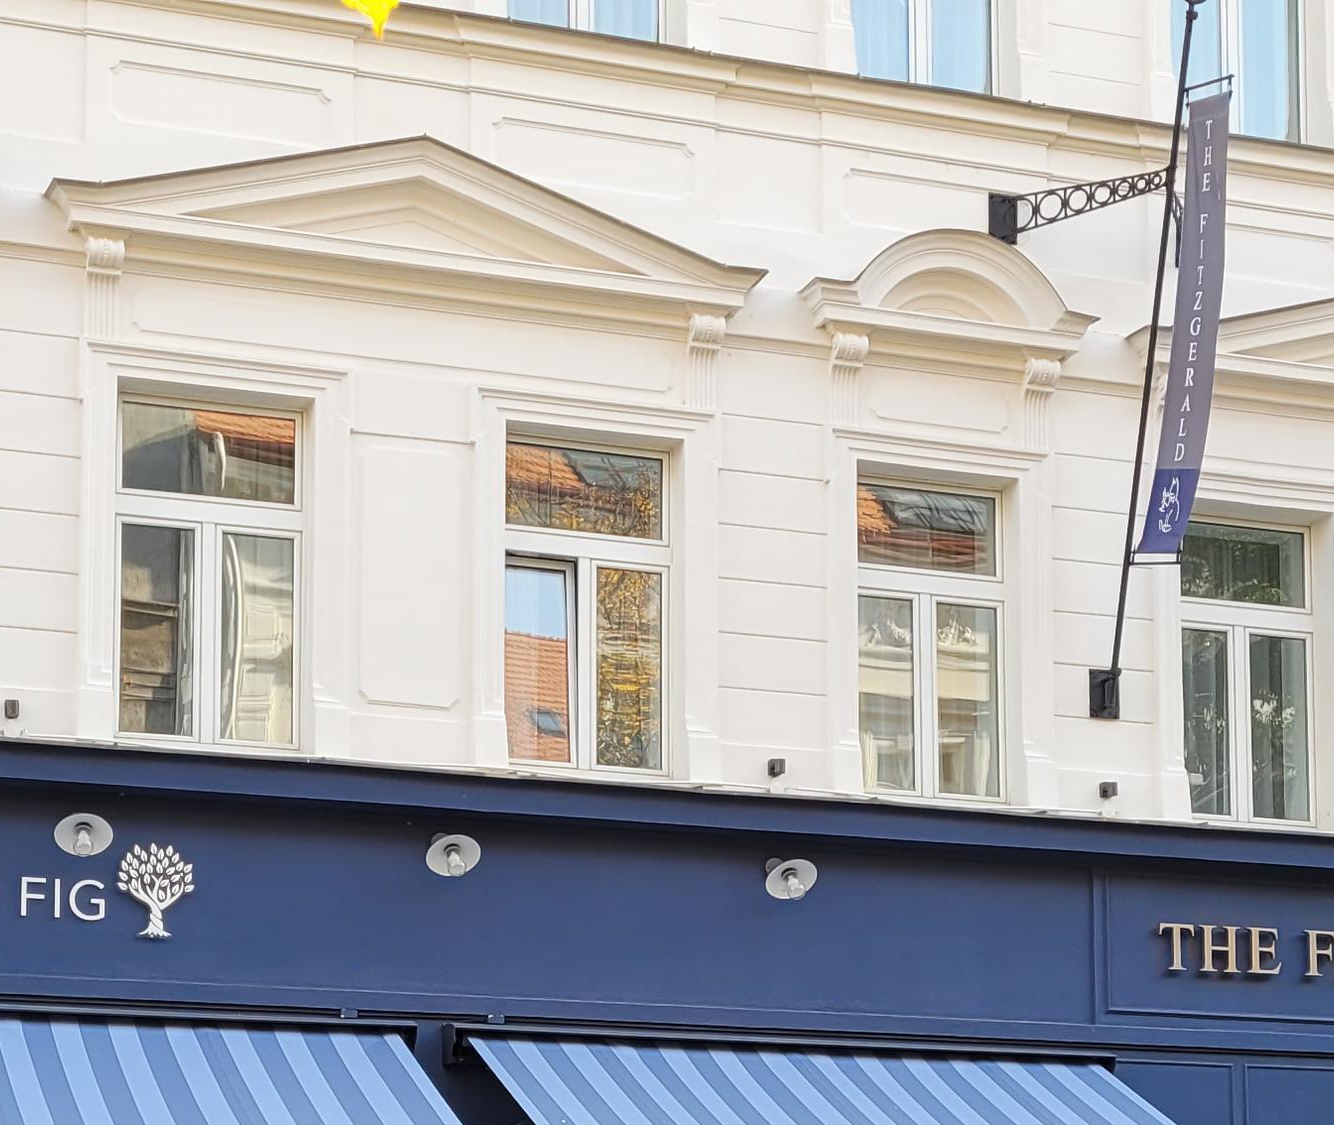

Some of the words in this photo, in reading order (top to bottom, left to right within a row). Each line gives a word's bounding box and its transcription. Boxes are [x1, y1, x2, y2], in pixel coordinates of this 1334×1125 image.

[1201, 119, 1214, 193] THE
[1173, 212, 1209, 463] FITZGERALD
[20, 876, 107, 921] FIG
[1158, 922, 1283, 976] THE
